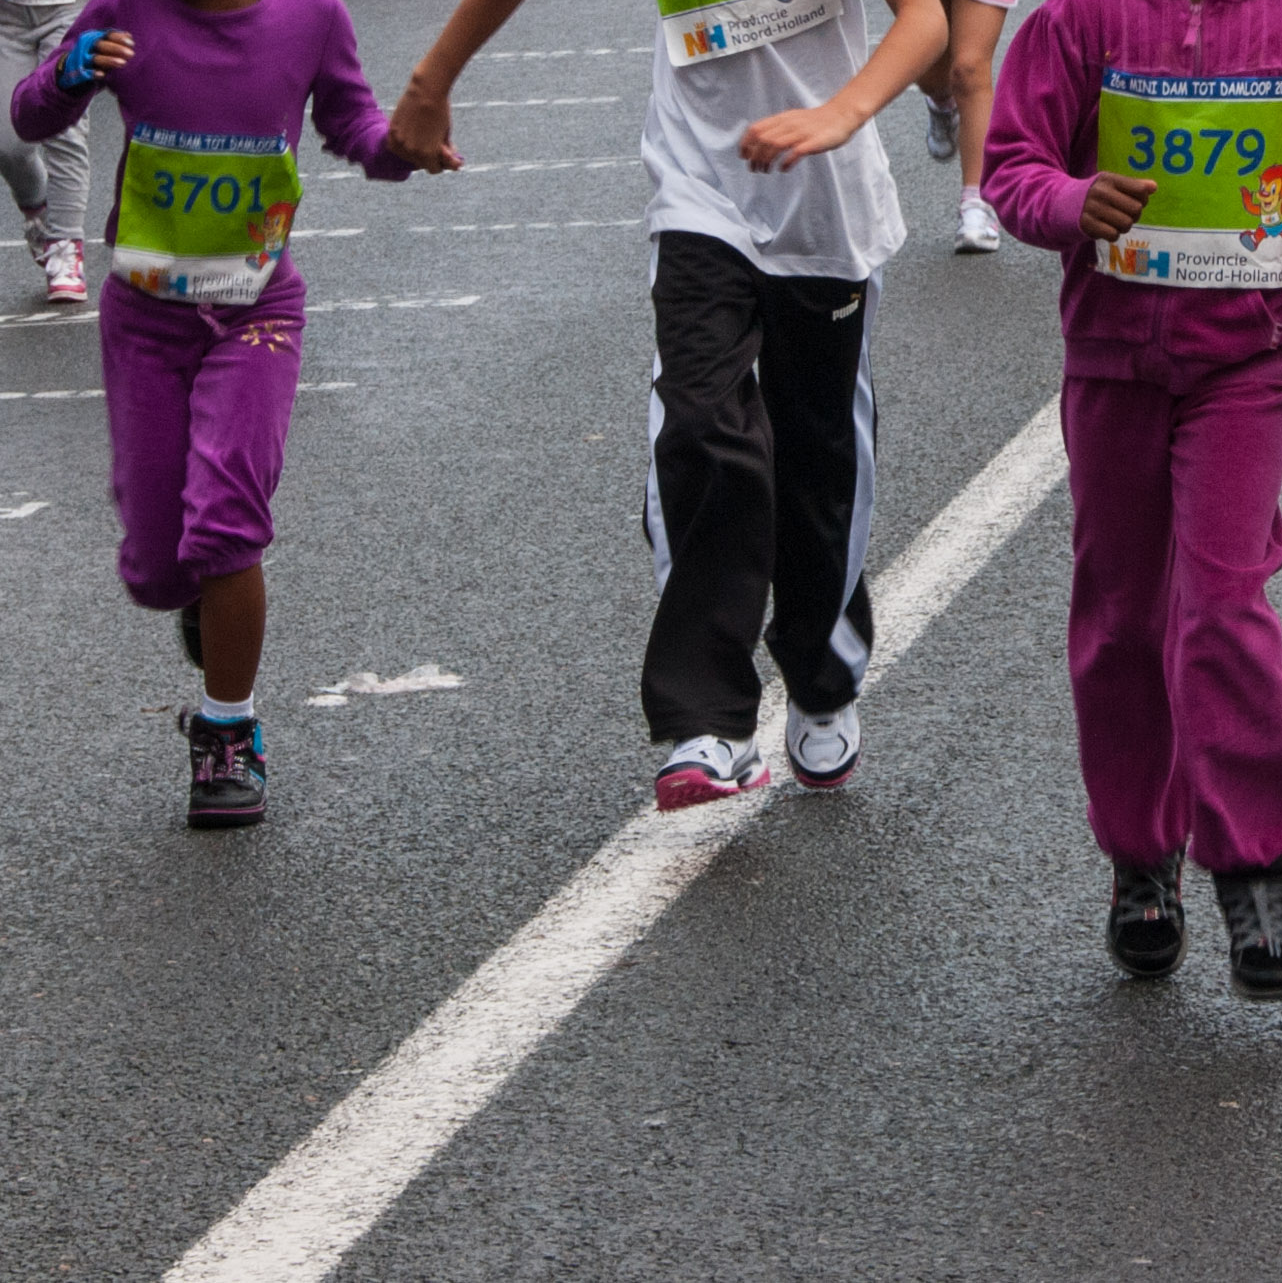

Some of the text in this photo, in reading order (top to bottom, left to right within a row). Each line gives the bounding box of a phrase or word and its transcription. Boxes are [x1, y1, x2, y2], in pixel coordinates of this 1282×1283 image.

[728, 7, 788, 33] Provincie
[731, 5, 826, 46] Noord-Holland
[1129, 77, 1158, 95] MINI
[1162, 81, 1188, 96] DAM
[1192, 81, 1216, 96] TOT
[1220, 80, 1271, 96] DAMLOOP
[1127, 124, 1267, 177] 3879
[151, 170, 264, 214] 3701
[1176, 251, 1248, 267] Provincie
[192, 275, 253, 288] Provincie
